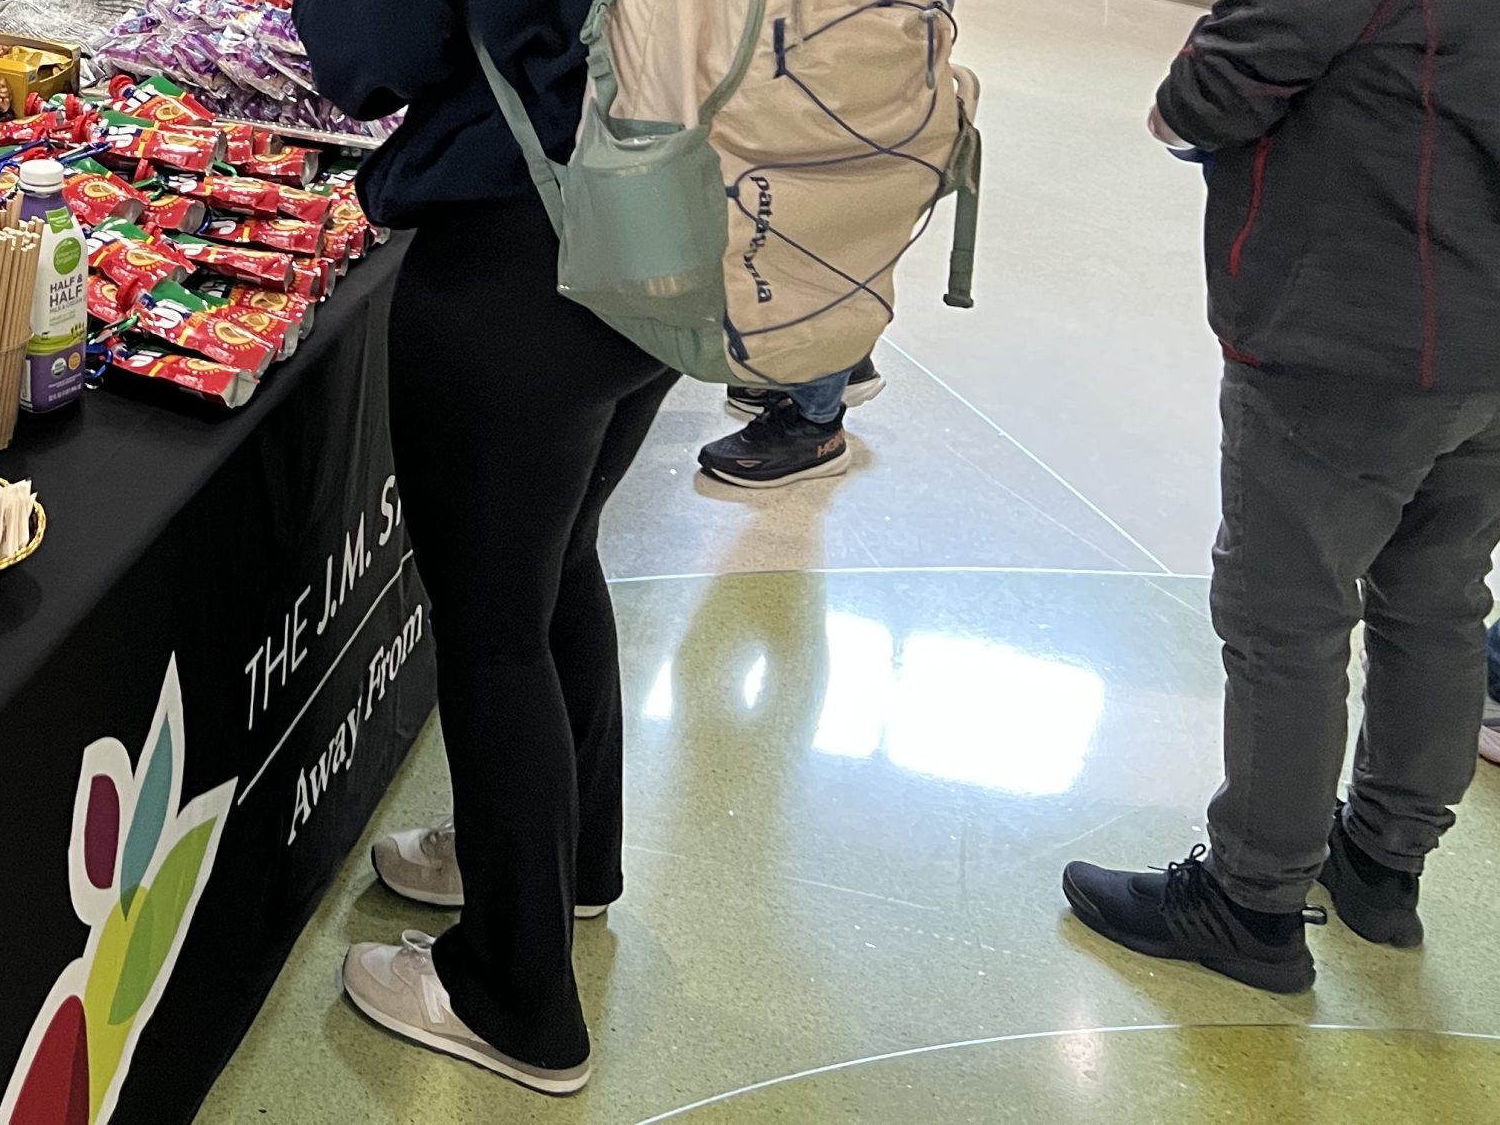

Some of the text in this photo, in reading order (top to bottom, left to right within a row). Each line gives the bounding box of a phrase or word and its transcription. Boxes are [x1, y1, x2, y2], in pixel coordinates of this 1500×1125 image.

[49, 284, 83, 308] HALF
[50, 275, 76, 293] HALF
[245, 585, 312, 731] THE
[316, 511, 372, 635] J.M.
[287, 603, 424, 847] Away From
